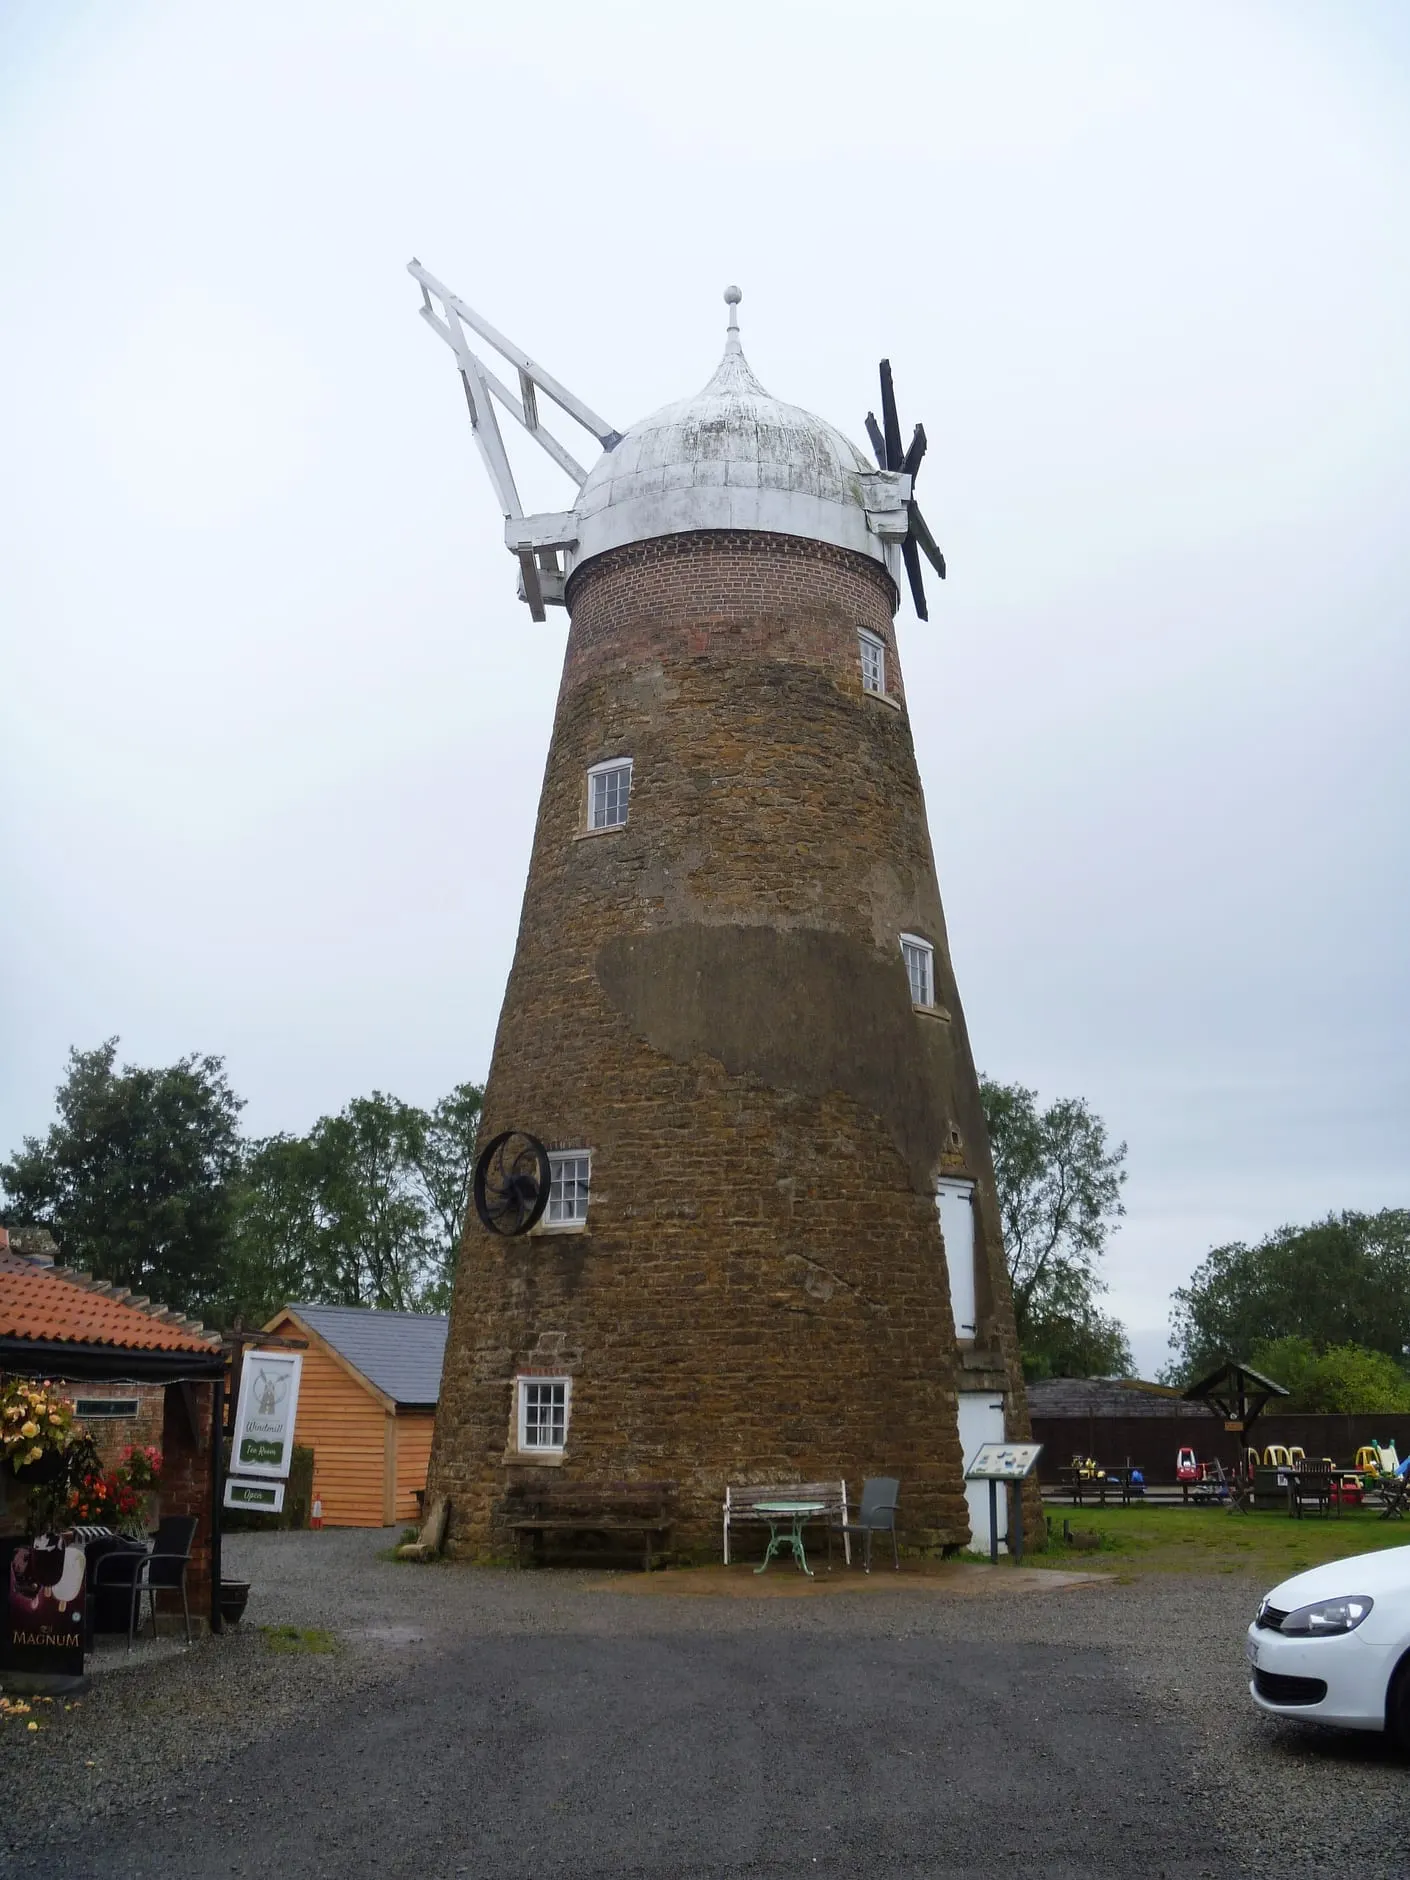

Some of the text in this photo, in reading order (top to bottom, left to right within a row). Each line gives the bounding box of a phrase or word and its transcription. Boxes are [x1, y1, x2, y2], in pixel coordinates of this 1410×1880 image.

[246, 1421, 283, 1433] Windmill
[247, 1445, 276, 1457] Tea Room
[244, 1489, 262, 1501] Open
[13, 1631, 80, 1647] MAGNUM
